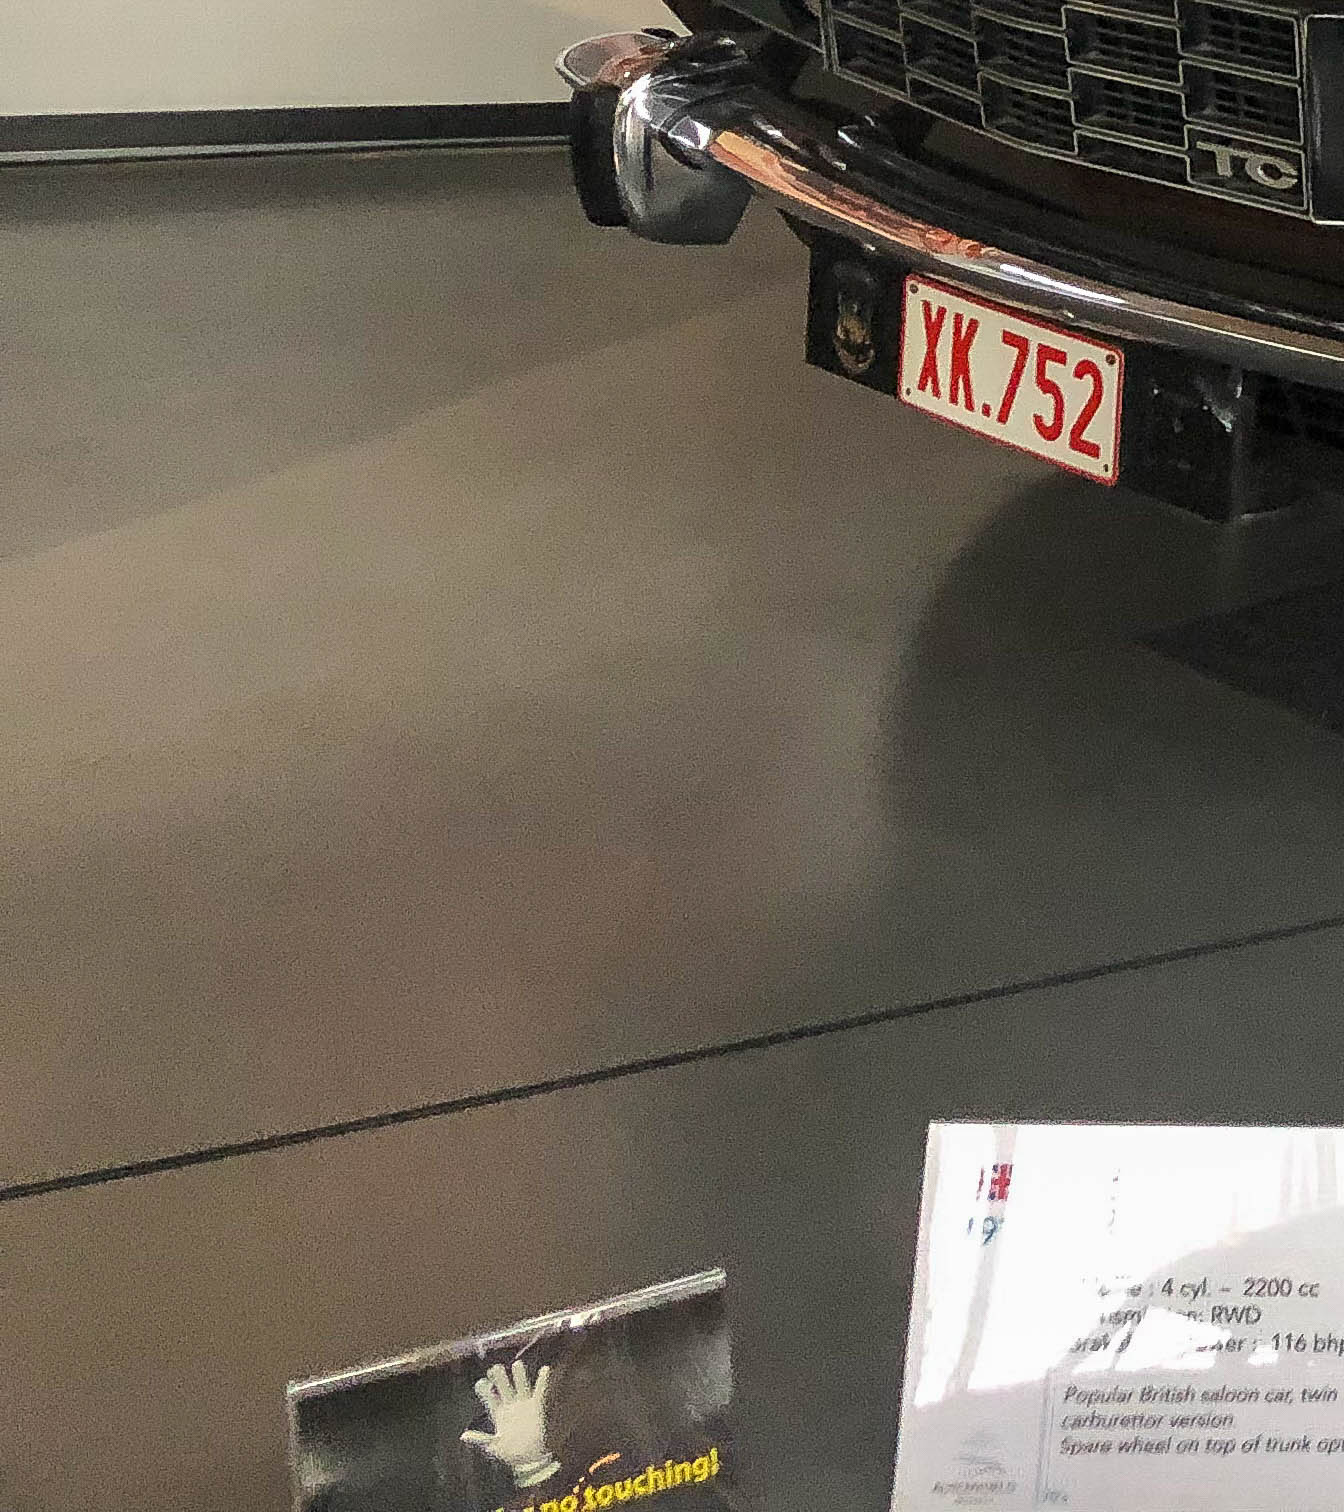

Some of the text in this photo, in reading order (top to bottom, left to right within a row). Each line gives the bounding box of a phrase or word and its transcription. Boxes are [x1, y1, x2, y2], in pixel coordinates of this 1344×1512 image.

[1196, 141, 1298, 189] TC
[918, 299, 1104, 459] XK.752
[1161, 1277, 1175, 1297] 4
[1243, 1276, 1293, 1298] 2200
[1298, 1282, 1320, 1298] cc
[1211, 1304, 1261, 1325] RWD
[1272, 1332, 1307, 1353] 116
[1064, 1384, 1339, 1407] Popular British saloon car, twin
[1060, 1410, 1234, 1430] carburettor version
[1059, 1436, 1113, 1456] Spare
[1118, 1435, 1172, 1454] wheel
[1176, 1439, 1200, 1454] on
[1204, 1437, 1237, 1457] top
[1241, 1433, 1264, 1454] of
[1265, 1434, 1312, 1454] trunk
[582, 1447, 721, 1512] touching!
